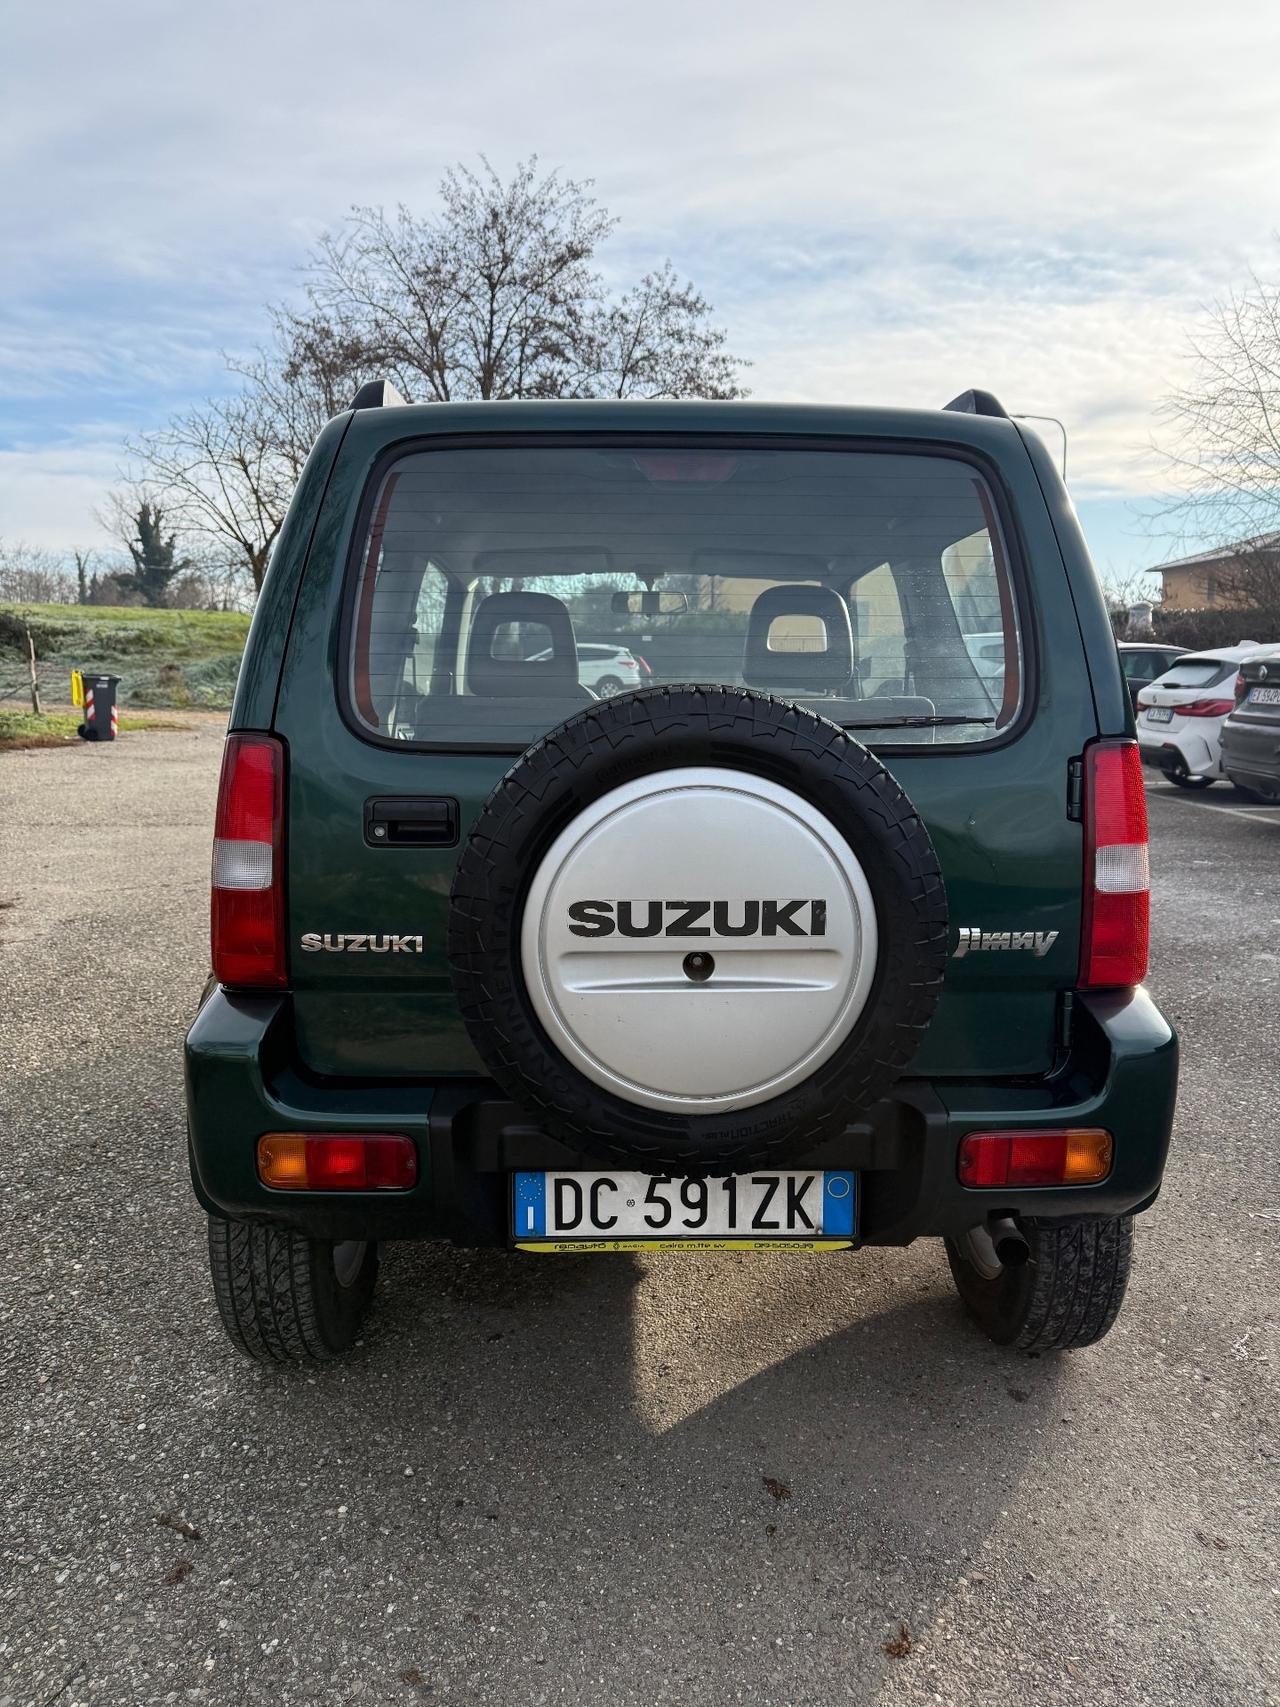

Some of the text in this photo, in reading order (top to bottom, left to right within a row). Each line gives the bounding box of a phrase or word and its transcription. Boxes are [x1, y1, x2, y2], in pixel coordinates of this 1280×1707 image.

[568, 899, 827, 938] SUZUKI
[301, 933, 423, 954] SUZUKI
[554, 1175, 816, 1230] DC 591ZK
